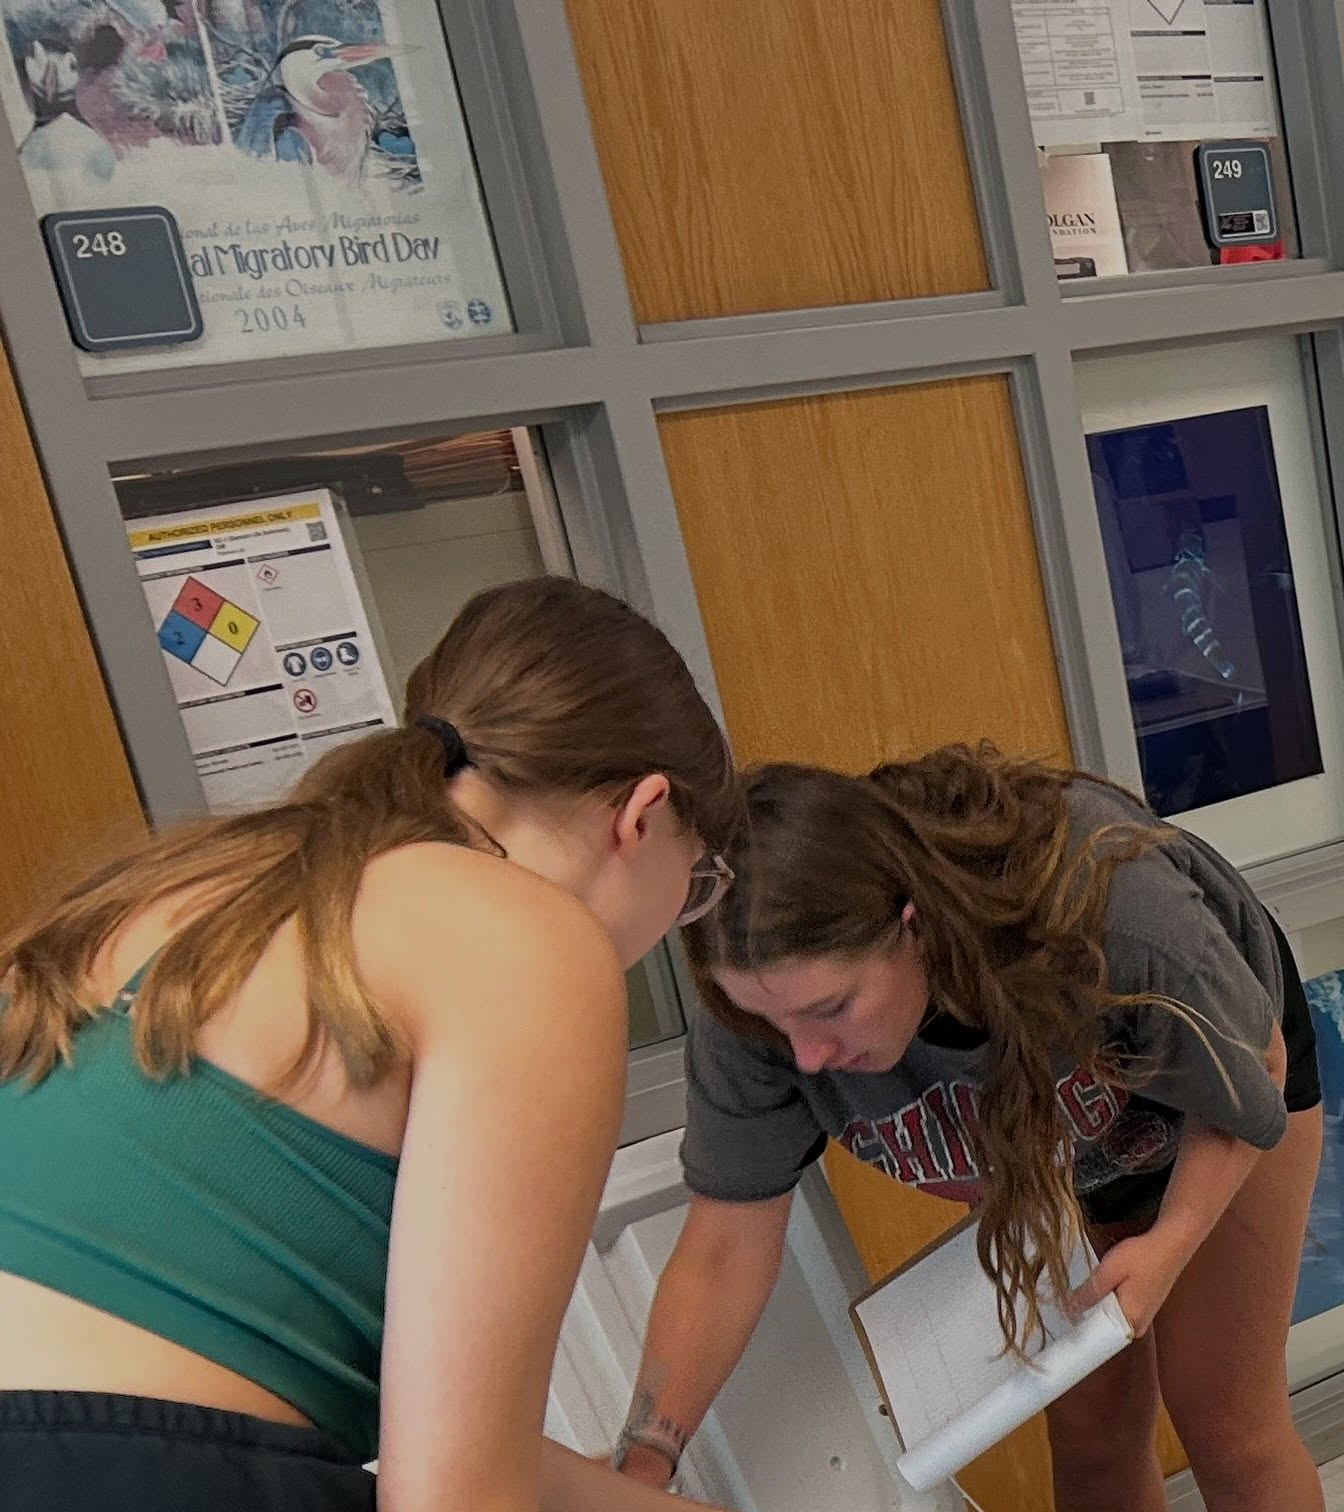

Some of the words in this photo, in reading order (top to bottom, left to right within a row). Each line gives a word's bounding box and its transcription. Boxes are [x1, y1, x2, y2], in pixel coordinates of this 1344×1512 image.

[1213, 160, 1242, 179] 249
[72, 231, 127, 258] 248
[214, 239, 335, 281] Migratory
[339, 233, 391, 268] Bird
[391, 231, 440, 262] Day
[233, 303, 307, 334] 2004
[228, 621, 239, 636] 0
